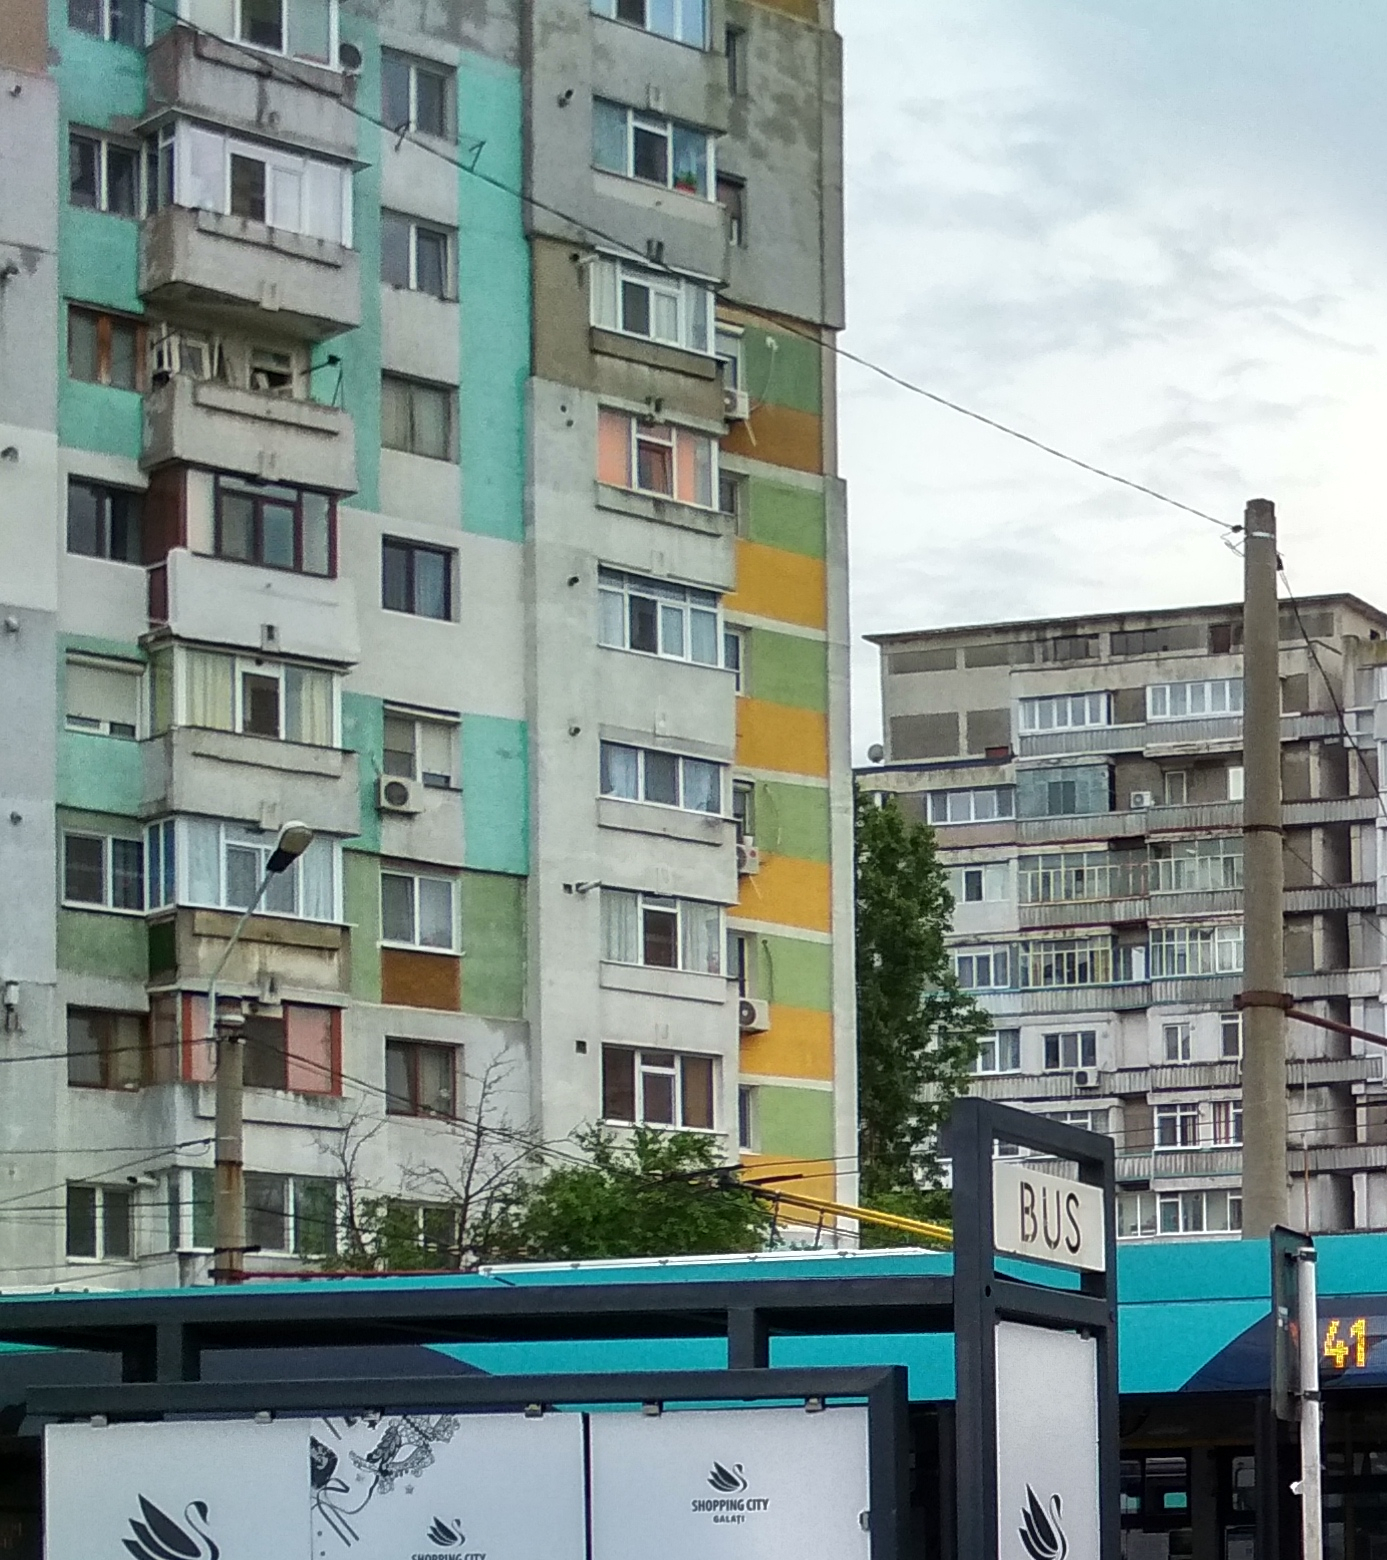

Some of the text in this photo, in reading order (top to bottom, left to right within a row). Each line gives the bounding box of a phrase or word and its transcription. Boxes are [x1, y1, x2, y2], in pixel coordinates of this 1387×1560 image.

[1019, 1181, 1081, 1254] BUS
[1323, 1317, 1367, 1368] 41
[690, 1498, 769, 1512] SHOPPING CITY
